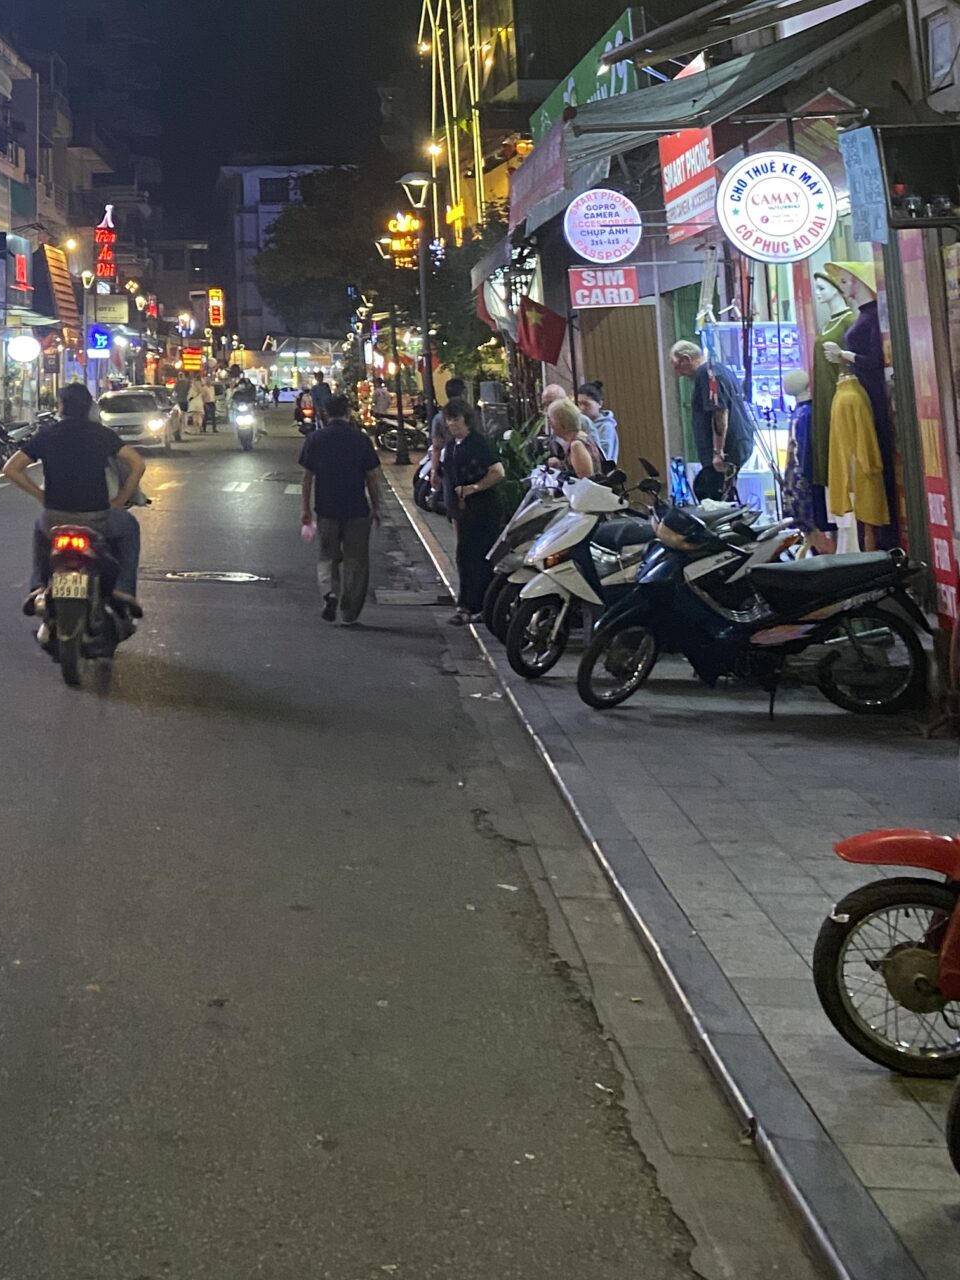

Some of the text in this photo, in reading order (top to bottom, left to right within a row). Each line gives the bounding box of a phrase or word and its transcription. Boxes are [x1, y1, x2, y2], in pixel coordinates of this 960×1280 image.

[663, 137, 712, 193] SMART PHONE
[730, 159, 824, 202] CHO THUÊ XE MÁY
[570, 191, 634, 216] SMART PHONE
[586, 203, 616, 211] GOPRO
[751, 191, 801, 206] CAMAY
[584, 211, 620, 219] CAMERA
[576, 238, 634, 260] PASSPORT
[581, 269, 625, 287] SIM
[575, 287, 635, 305] CARD
